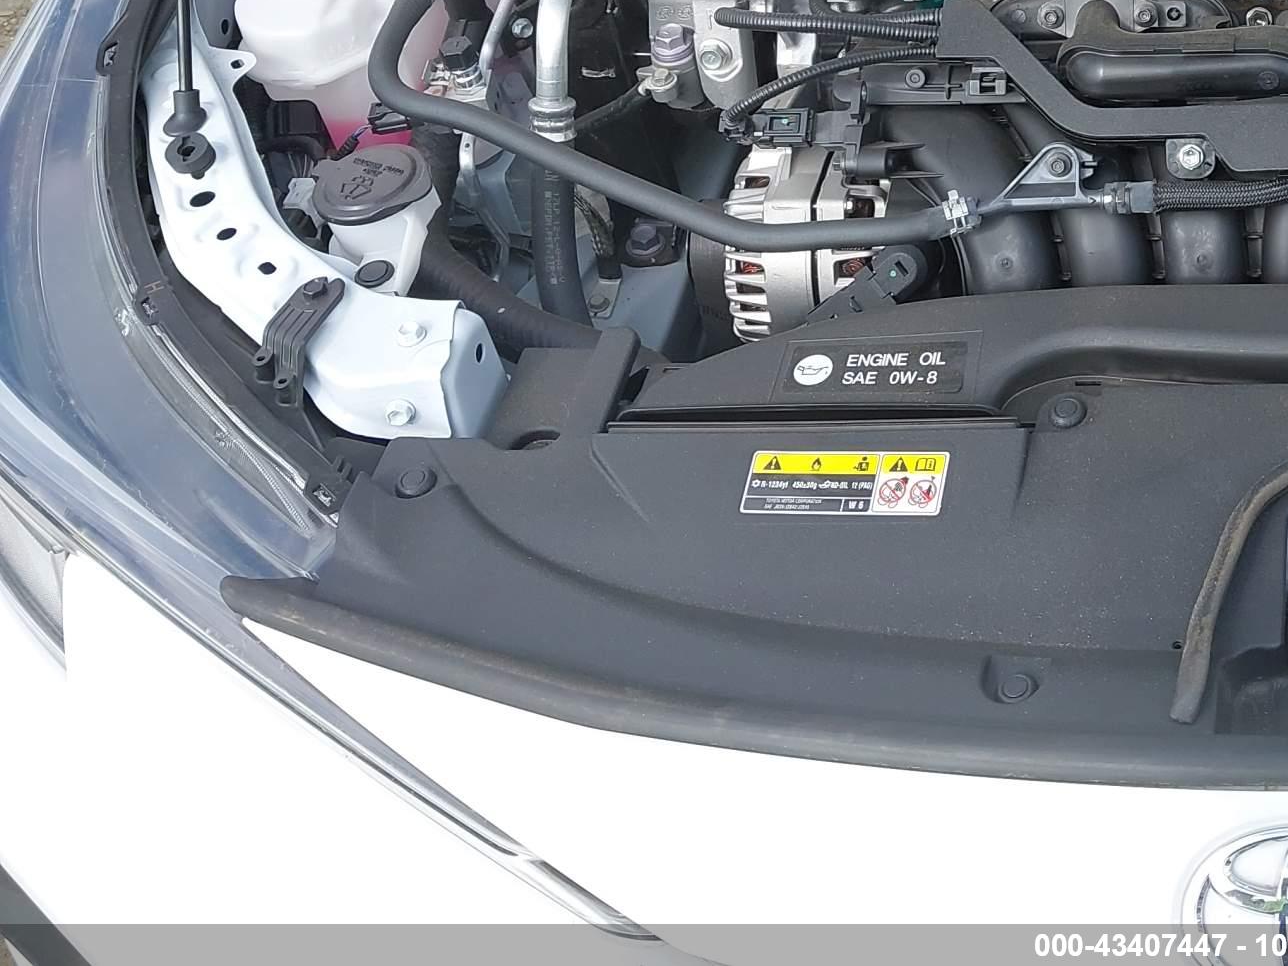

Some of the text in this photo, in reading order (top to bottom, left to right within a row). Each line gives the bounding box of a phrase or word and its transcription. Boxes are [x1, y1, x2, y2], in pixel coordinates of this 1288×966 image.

[846, 351, 947, 368] ENGINE OIL
[841, 370, 938, 385] SAE 0W-8
